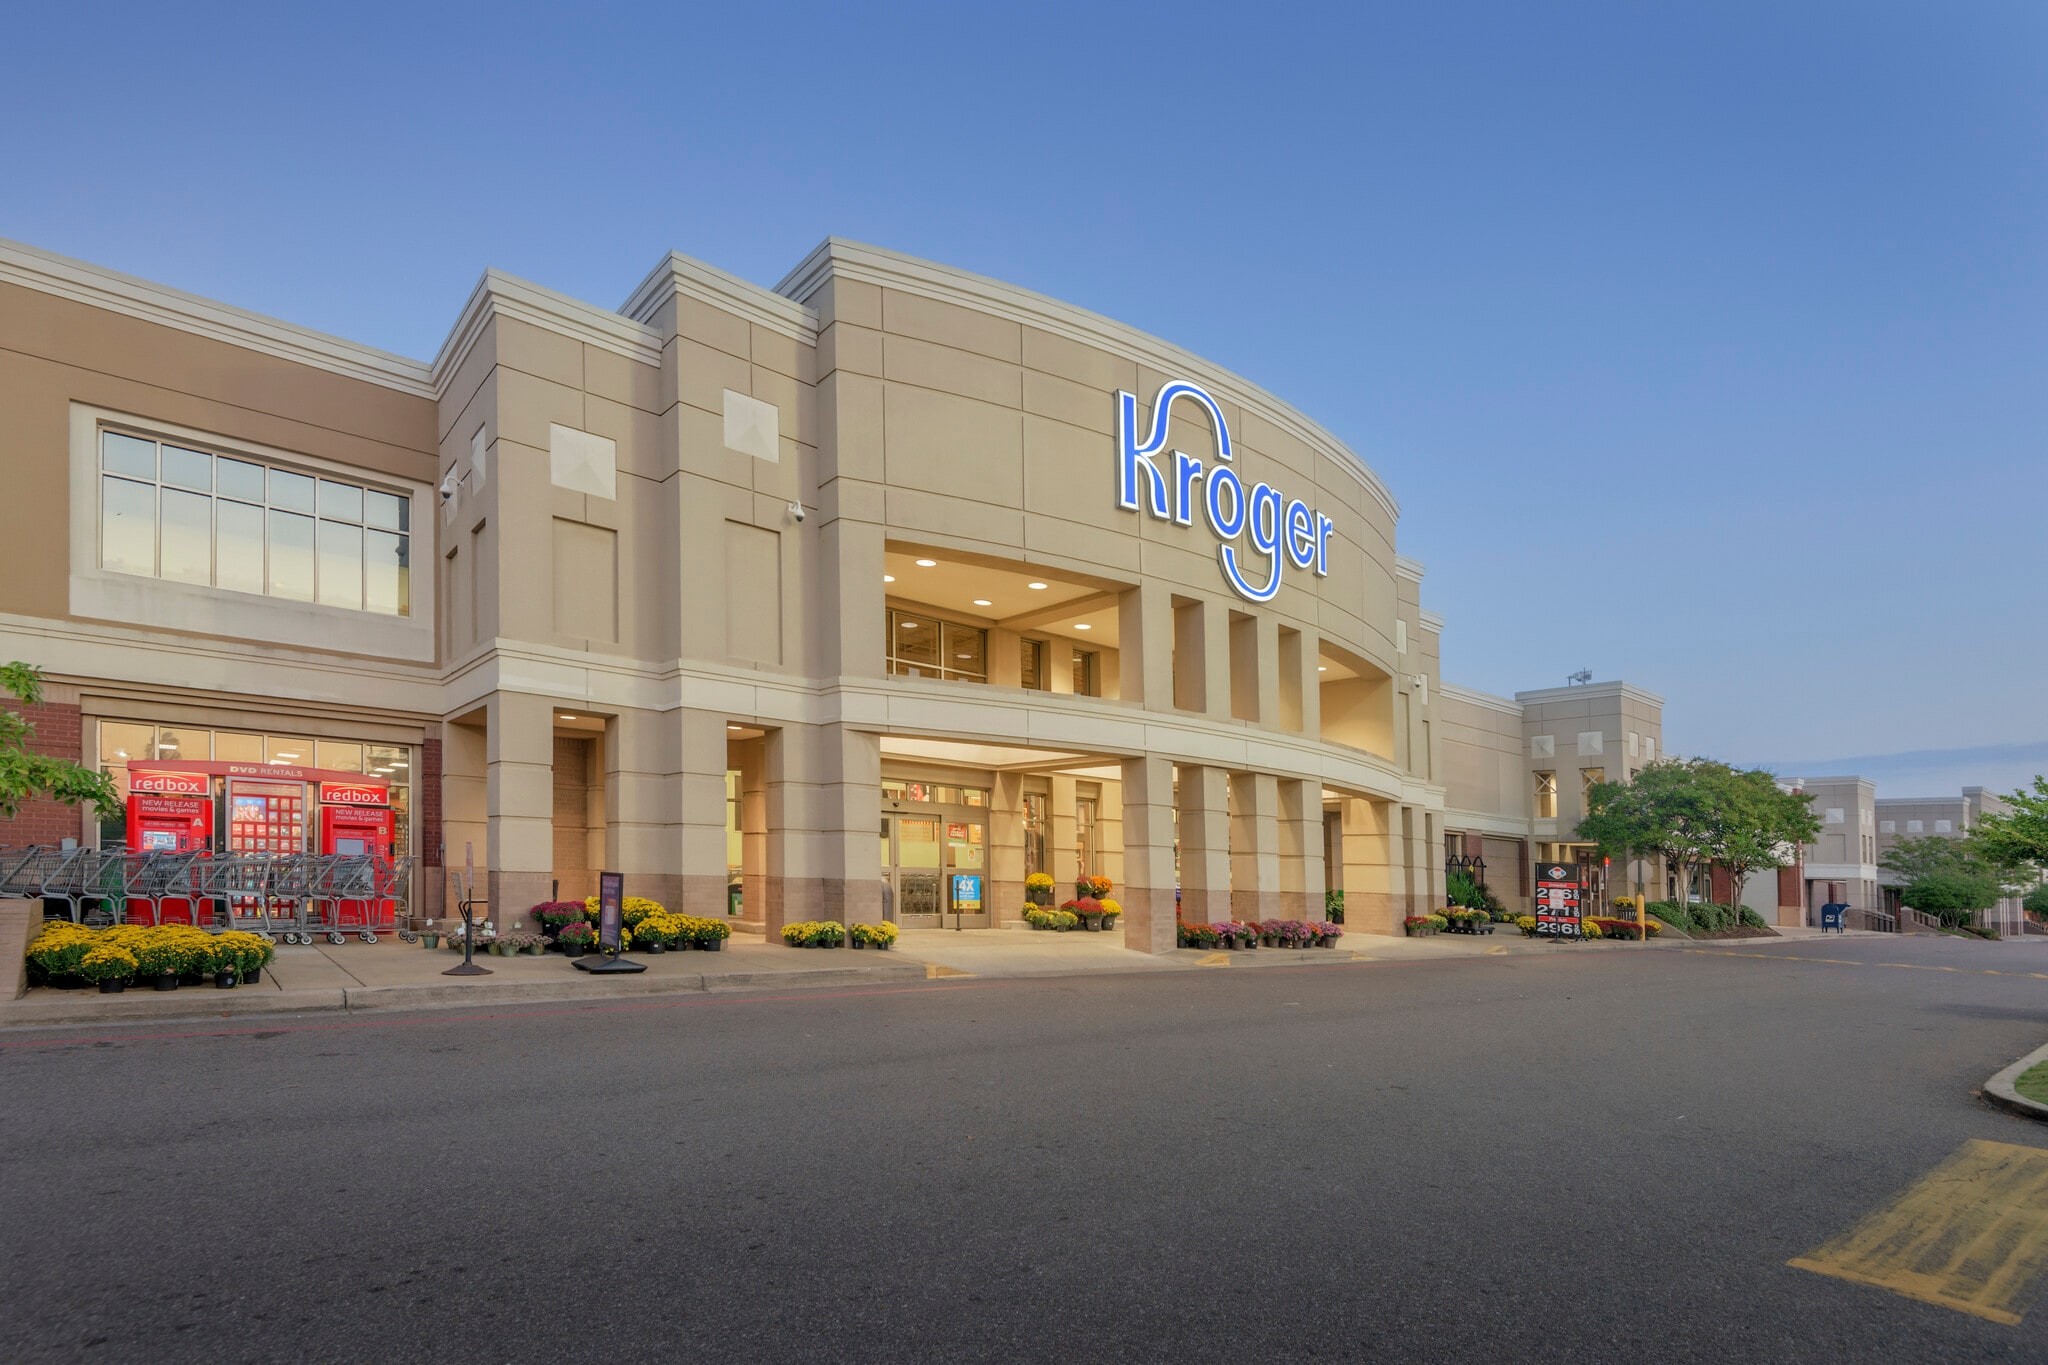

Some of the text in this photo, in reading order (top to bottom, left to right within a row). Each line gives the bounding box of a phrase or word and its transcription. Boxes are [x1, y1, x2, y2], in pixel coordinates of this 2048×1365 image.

[1115, 380, 1333, 602] Kroger
[229, 765, 304, 778] DVD RENTALS
[135, 778, 200, 792] redbox
[326, 790, 381, 803] redbox
[142, 799, 162, 807] NEW
[354, 810, 384, 818] RELEASE
[192, 817, 204, 827] A
[378, 826, 388, 835] B
[1537, 888, 1572, 900] 26
